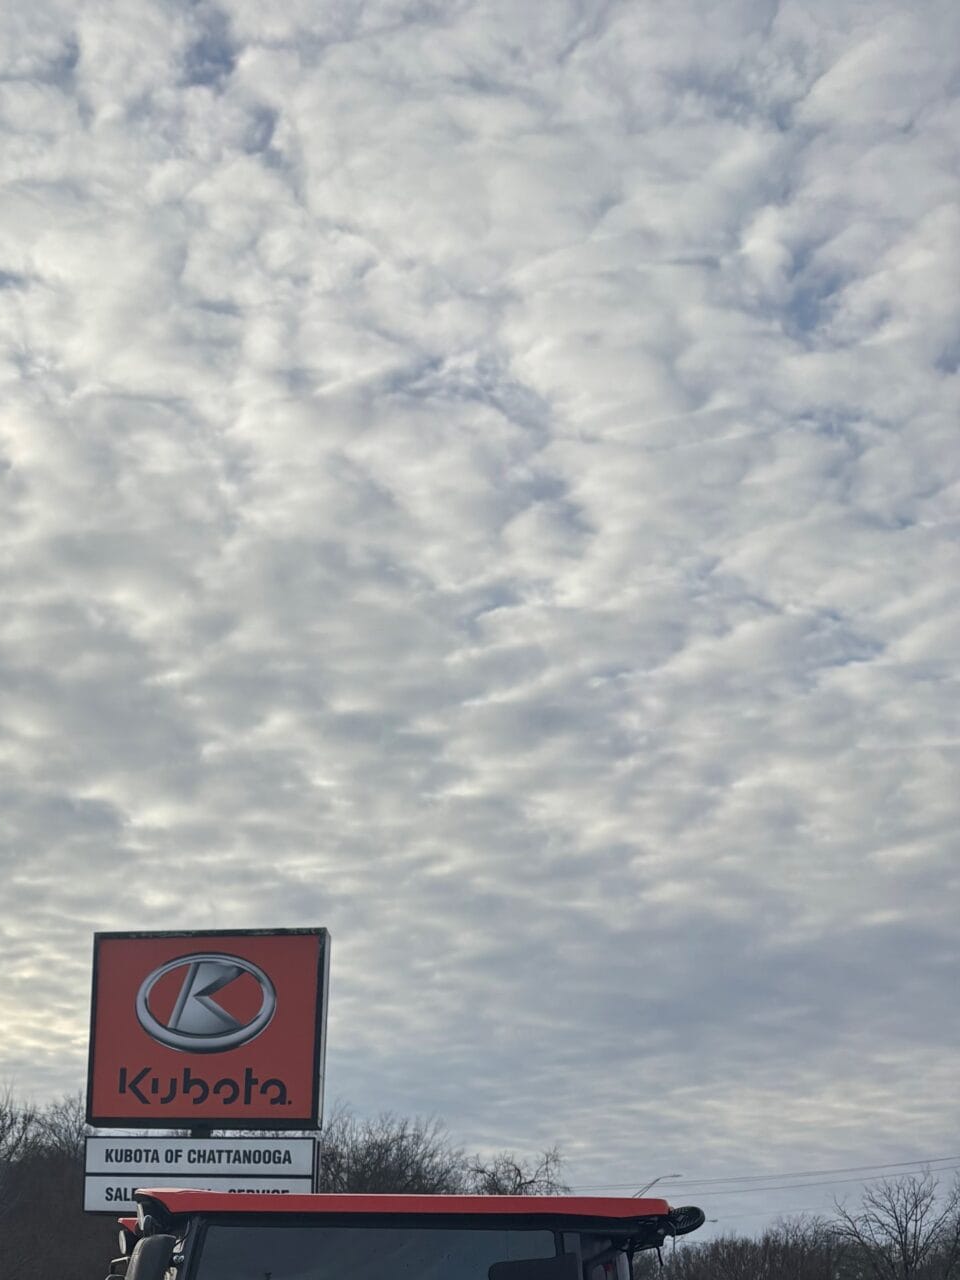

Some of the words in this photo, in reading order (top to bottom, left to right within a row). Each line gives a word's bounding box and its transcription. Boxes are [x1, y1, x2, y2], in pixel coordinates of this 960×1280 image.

[118, 1067, 287, 1105] Kubota
[105, 1149, 160, 1163] KUBOTA
[165, 1149, 182, 1164] OF
[187, 1149, 292, 1165] CHATTANOOGA
